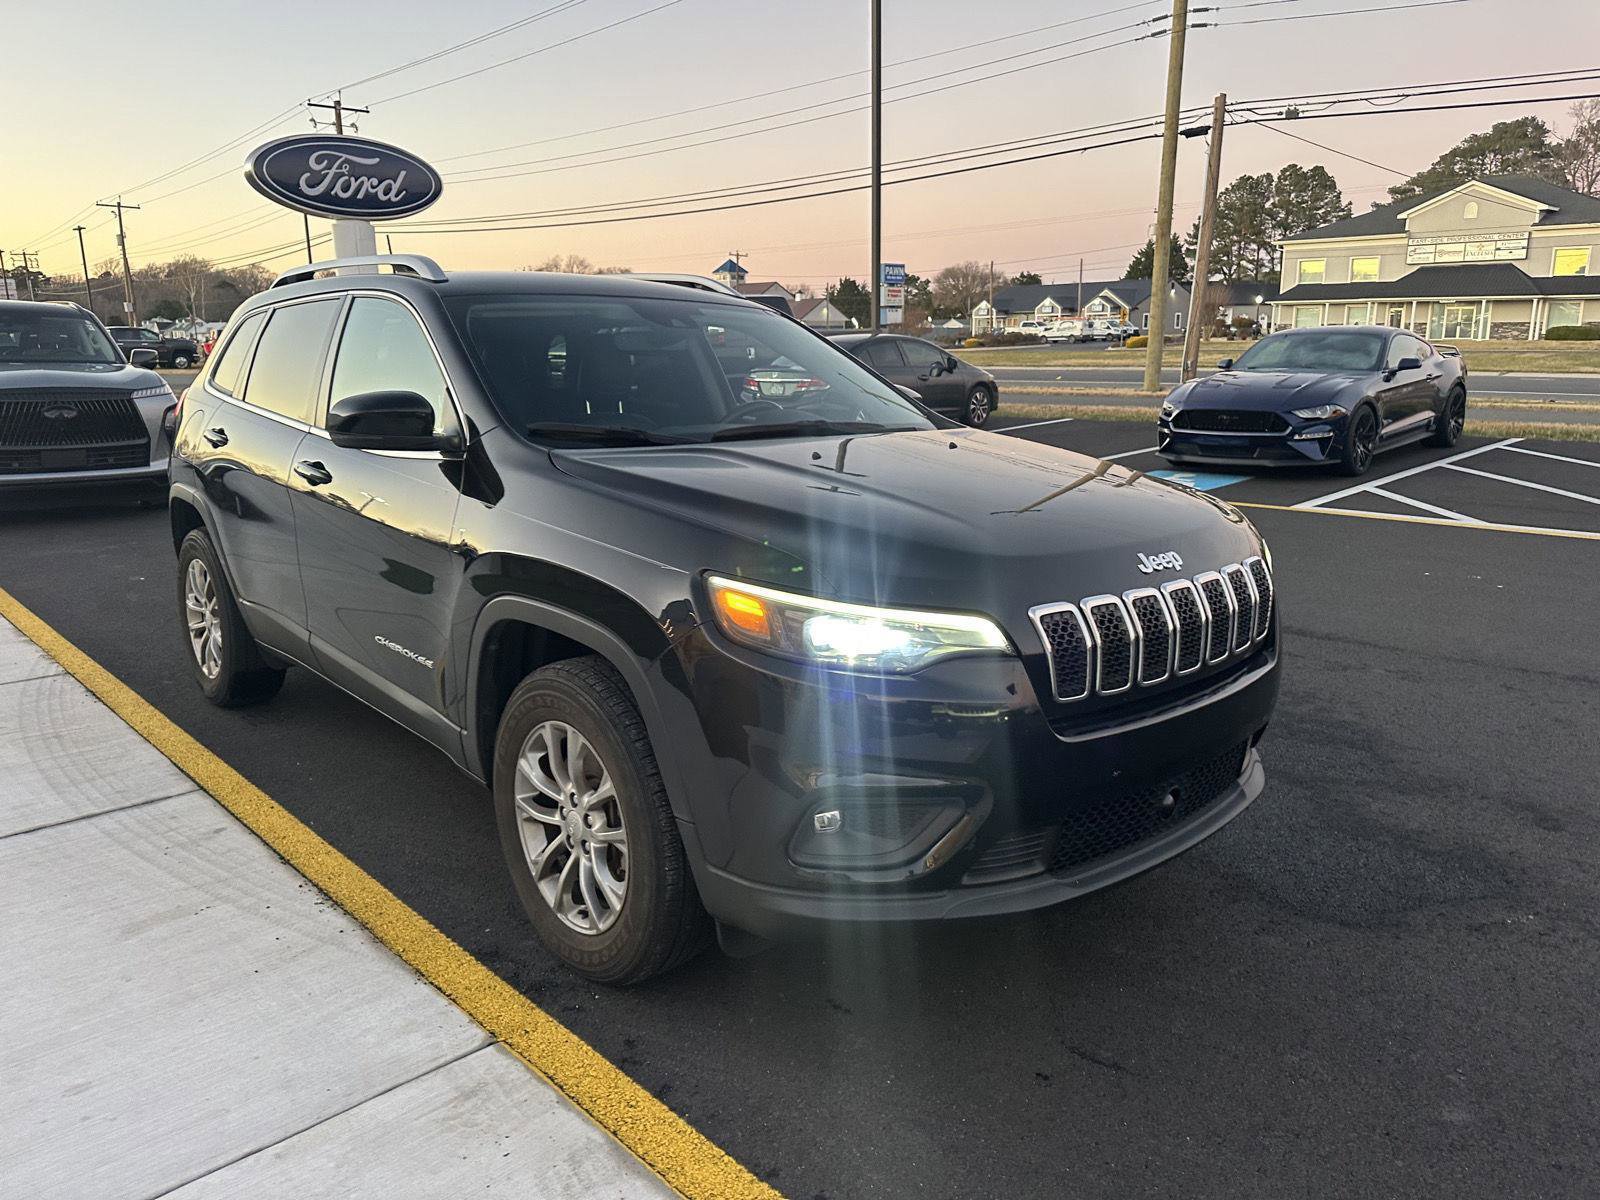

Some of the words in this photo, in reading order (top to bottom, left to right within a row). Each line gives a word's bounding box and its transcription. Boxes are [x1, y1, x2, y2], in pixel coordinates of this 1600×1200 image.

[299, 151, 407, 203] Ford
[1497, 232, 1526, 240] CENTER
[1136, 550, 1184, 573] Jeep
